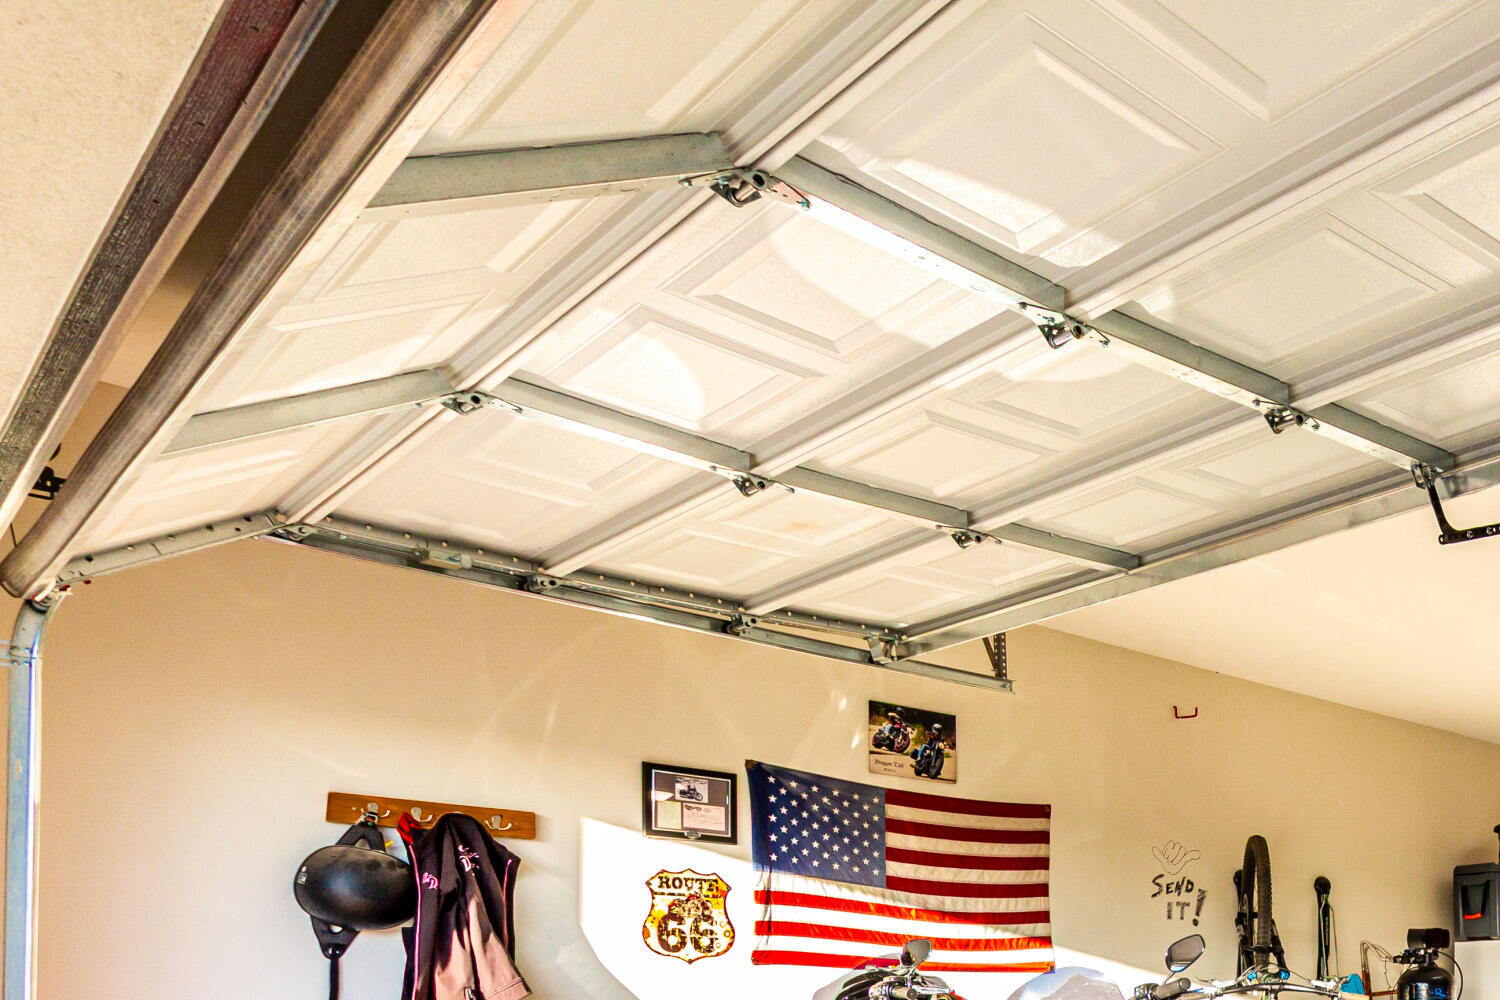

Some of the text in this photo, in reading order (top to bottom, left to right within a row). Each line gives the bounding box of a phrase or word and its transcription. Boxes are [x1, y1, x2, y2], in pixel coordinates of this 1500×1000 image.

[658, 876, 719, 892] ROUTE
[1151, 874, 1195, 898] SEND
[657, 914, 719, 953] 66
